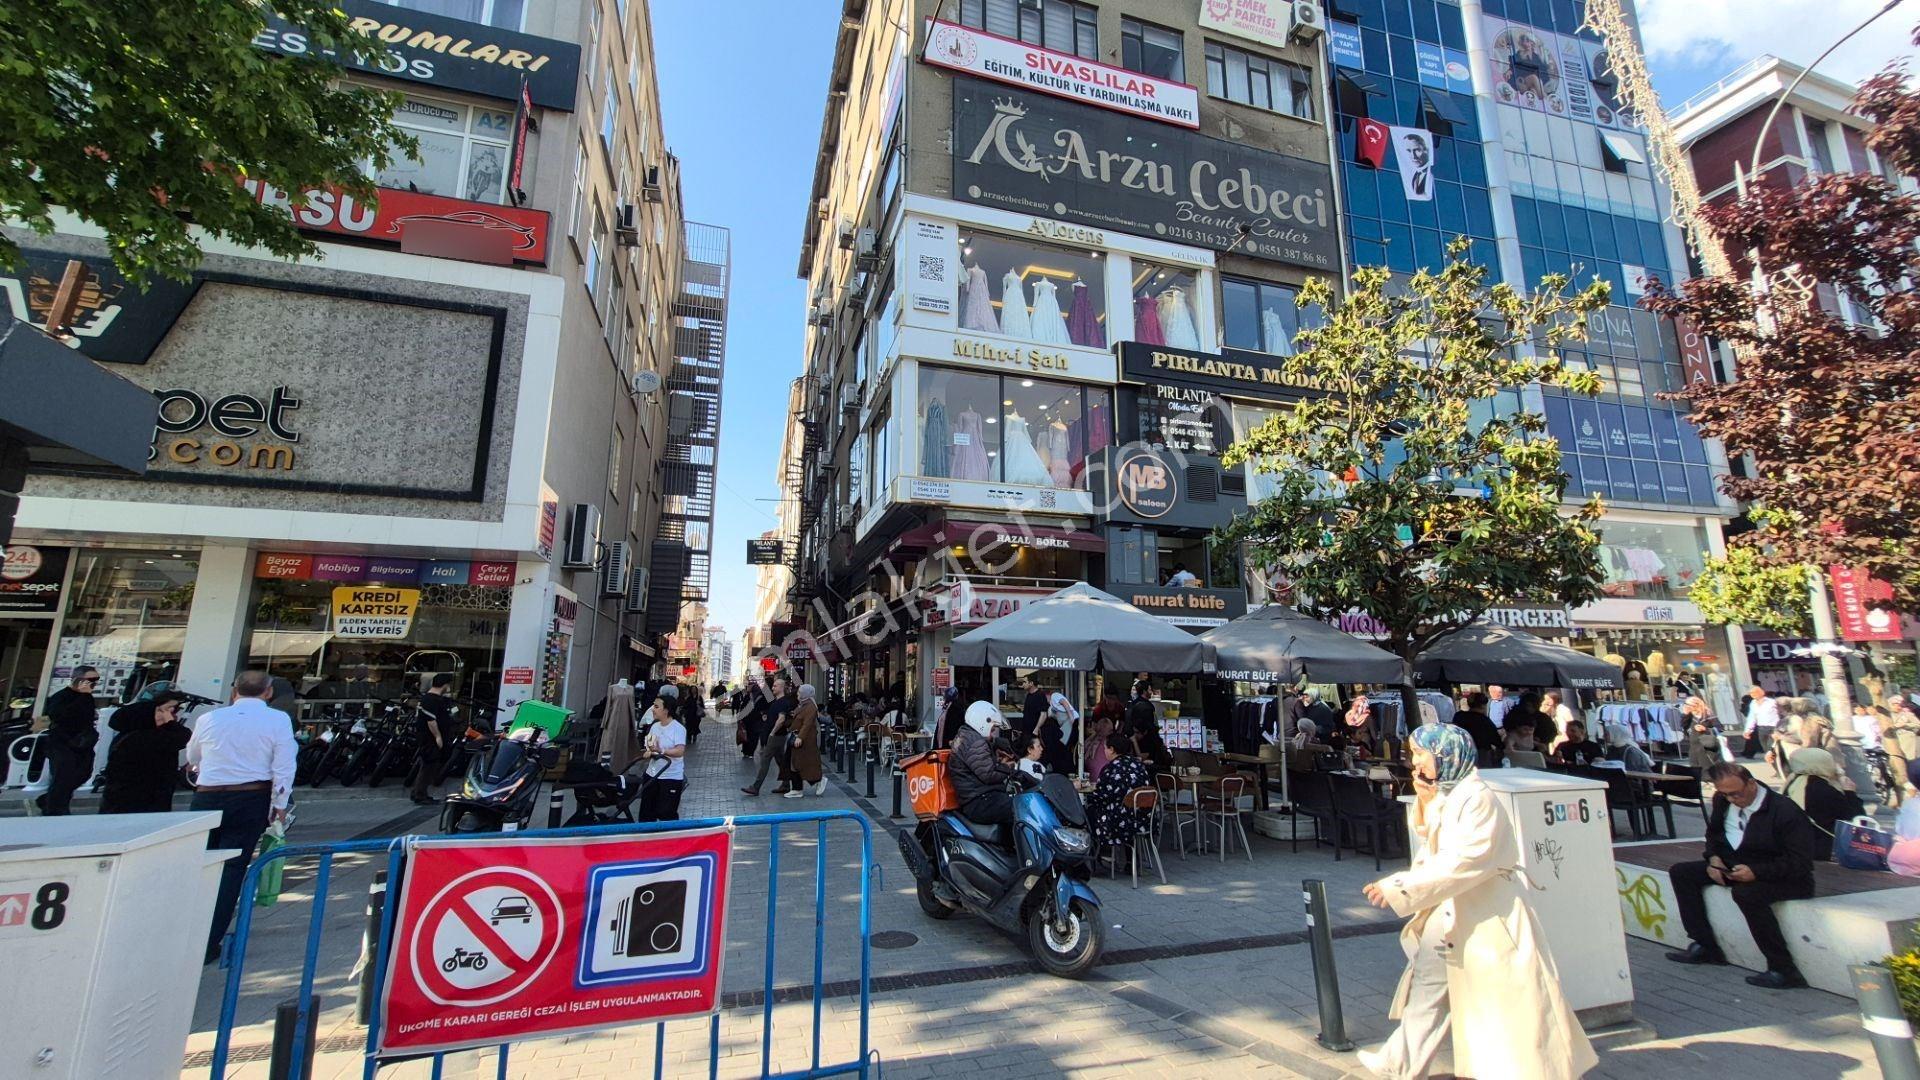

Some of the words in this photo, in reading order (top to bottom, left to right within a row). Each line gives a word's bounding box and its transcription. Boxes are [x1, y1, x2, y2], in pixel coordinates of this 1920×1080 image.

[1236, 0, 1267, 13] EMEK
[1235, 8, 1276, 29] PARTİSİ
[251, 28, 307, 54] ES
[350, 16, 550, 72] RUMLARI
[1025, 51, 1156, 99] SİVASLILAR
[984, 58, 1026, 83] EĞİTİM,
[1029, 71, 1071, 92] KÜLTÜR
[1074, 82, 1087, 95] VE
[1089, 86, 1162, 114] YARDIMLAŞMA
[1164, 104, 1193, 121] VAKFI
[477, 112, 507, 131] A2
[1047, 129, 1177, 197] Arzu
[1190, 160, 1327, 228] Cebeci
[1175, 202, 1245, 238] Beauty
[1248, 218, 1311, 246] Center
[1168, 226, 1193, 239] 0216
[1195, 231, 1214, 243] 316
[1215, 234, 1228, 246] 22
[1258, 244, 1281, 256] 0551
[1283, 248, 1301, 260] 387
[1303, 252, 1315, 263] 86
[1316, 254, 1328, 265] 86
[953, 339, 1024, 364] Mihr-i
[1027, 348, 1069, 372] Şah
[1151, 350, 1258, 382] PIRLANTA
[1261, 368, 1321, 390] MODA
[1157, 384, 1214, 404] PIRLANTA
[151, 385, 300, 442] pet
[1174, 441, 1190, 450] KAT
[1138, 498, 1167, 508] saloon
[997, 533, 1031, 545] HAZAL
[1036, 536, 1070, 549] BÖREK
[4, 551, 28, 564] 24
[265, 556, 302, 567] Beyaz
[268, 566, 297, 577] Eşya
[317, 563, 360, 574] Mobilya
[370, 565, 415, 576] Bilgisayar
[431, 567, 456, 577] Halı
[480, 564, 508, 576] Çeyiz
[477, 573, 510, 583] Setleri
[352, 591, 401, 603] KREDİ
[1132, 593, 1184, 609] murat
[1188, 593, 1226, 610] büfe
[340, 604, 409, 616] KARTSIZ
[969, 598, 1021, 619] AZA
[369, 618, 407, 626] TAKSİTLE
[339, 625, 403, 636] ALIŞVERİŞ
[788, 649, 810, 659] DEDE
[1006, 655, 1040, 667] HAZAL
[1041, 655, 1076, 668] BÖREK
[1216, 670, 1250, 680] MURAT
[1252, 669, 1278, 681] BÜFE
[1412, 671, 1423, 680] FE
[1594, 677, 1614, 688] BÜFE
[1543, 800, 1555, 827] 5
[1578, 798, 1590, 824] 6
[31, 881, 70, 930] 8
[399, 1018, 441, 1034] UKOME
[444, 1013, 488, 1027] KARARI
[490, 1006, 533, 1022] GEREĞİ
[534, 1002, 568, 1016] CEZAİ
[569, 1000, 600, 1014] İŞLEM
[602, 989, 703, 1009] UYGULANMAKTADIR.
